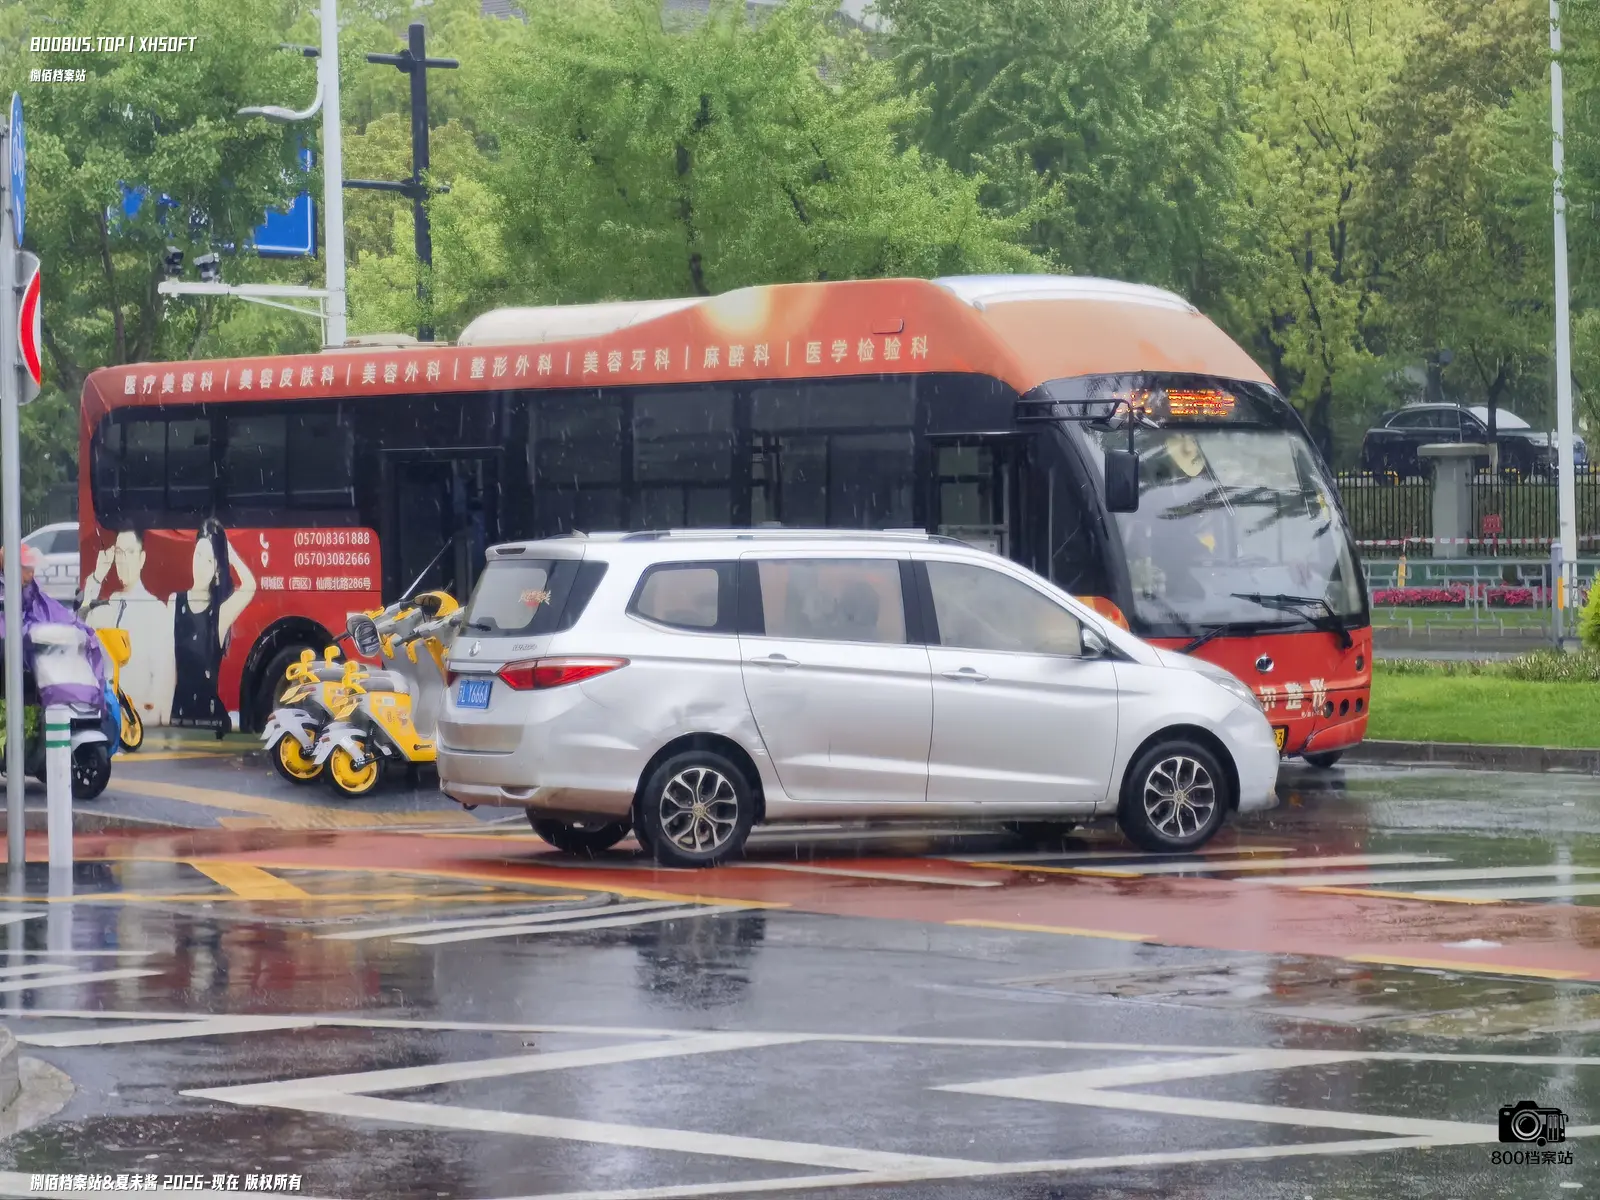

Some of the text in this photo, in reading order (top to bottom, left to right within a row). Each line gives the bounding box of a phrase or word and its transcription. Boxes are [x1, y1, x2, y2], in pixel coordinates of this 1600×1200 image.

[124, 335, 929, 395] 医疗美容科 美容皮肤科 美容外科 整形外科 美容牙科 麻醉科 医学检验科
[293, 531, 370, 548] (0570)8361888
[294, 552, 370, 568] (0570)3082666
